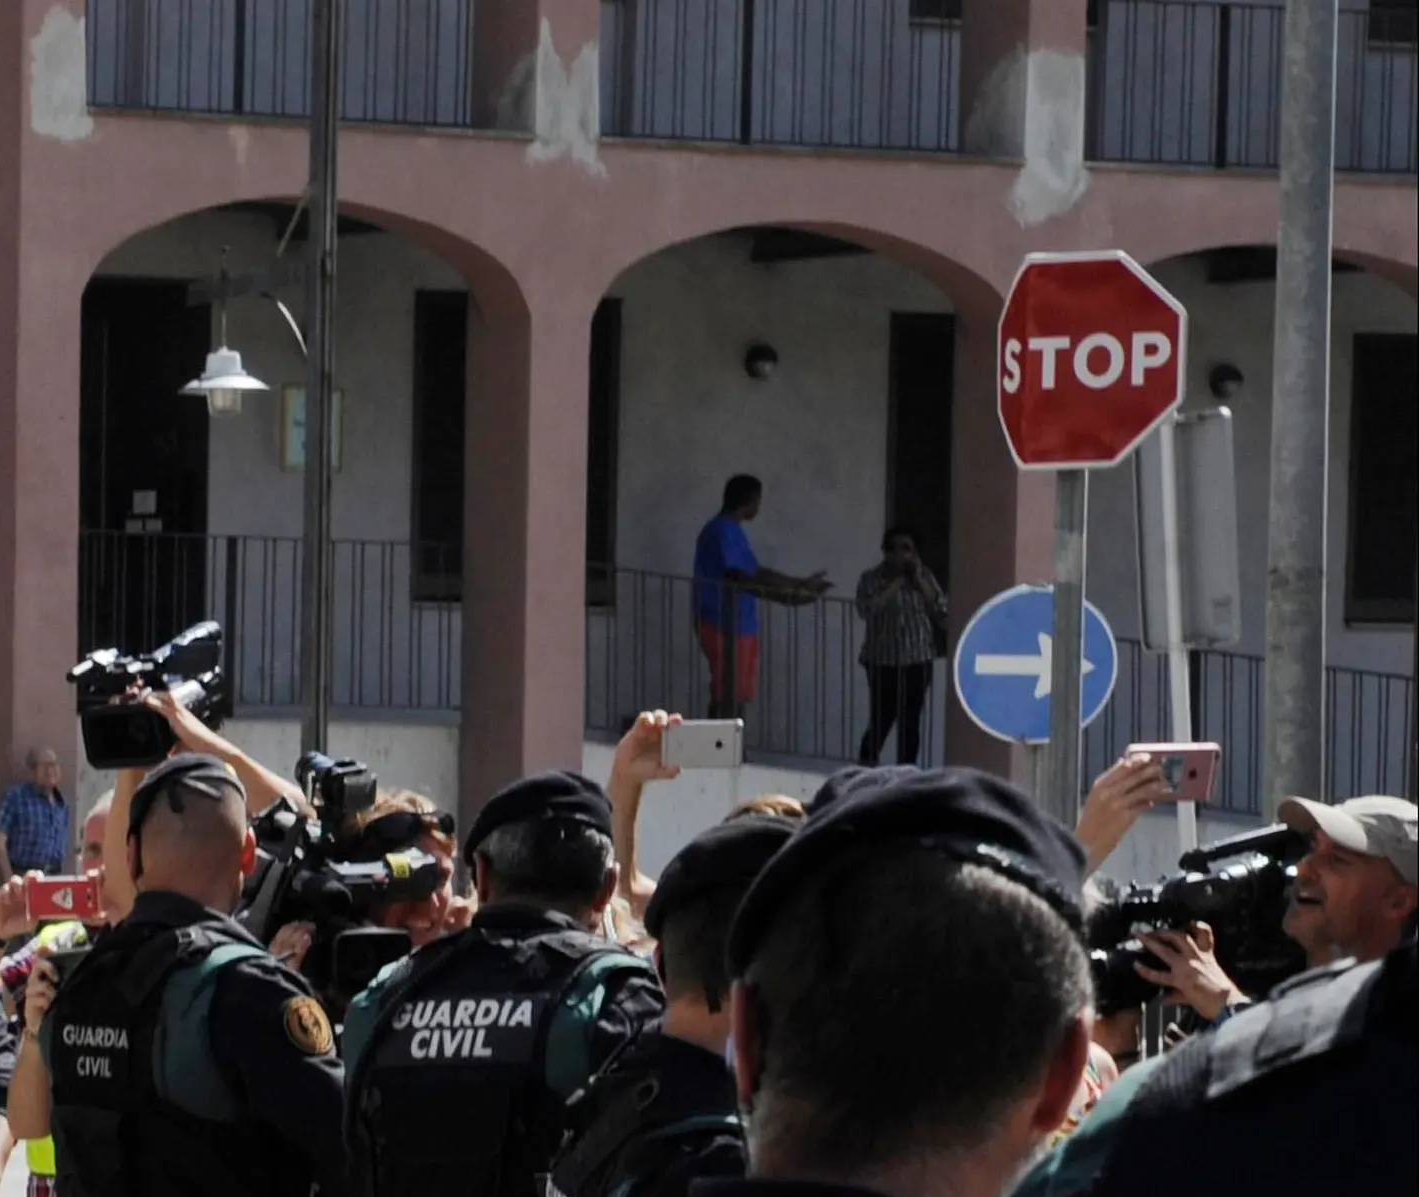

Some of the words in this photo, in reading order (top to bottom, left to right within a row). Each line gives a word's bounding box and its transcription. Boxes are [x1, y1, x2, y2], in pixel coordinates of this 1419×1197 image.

[1003, 332, 1172, 394] STOP
[392, 998, 533, 1031] GUARDIA
[63, 1024, 129, 1049] GUARDIA
[410, 1027, 493, 1059] CIVIL
[76, 1055, 112, 1078] CIVIL
